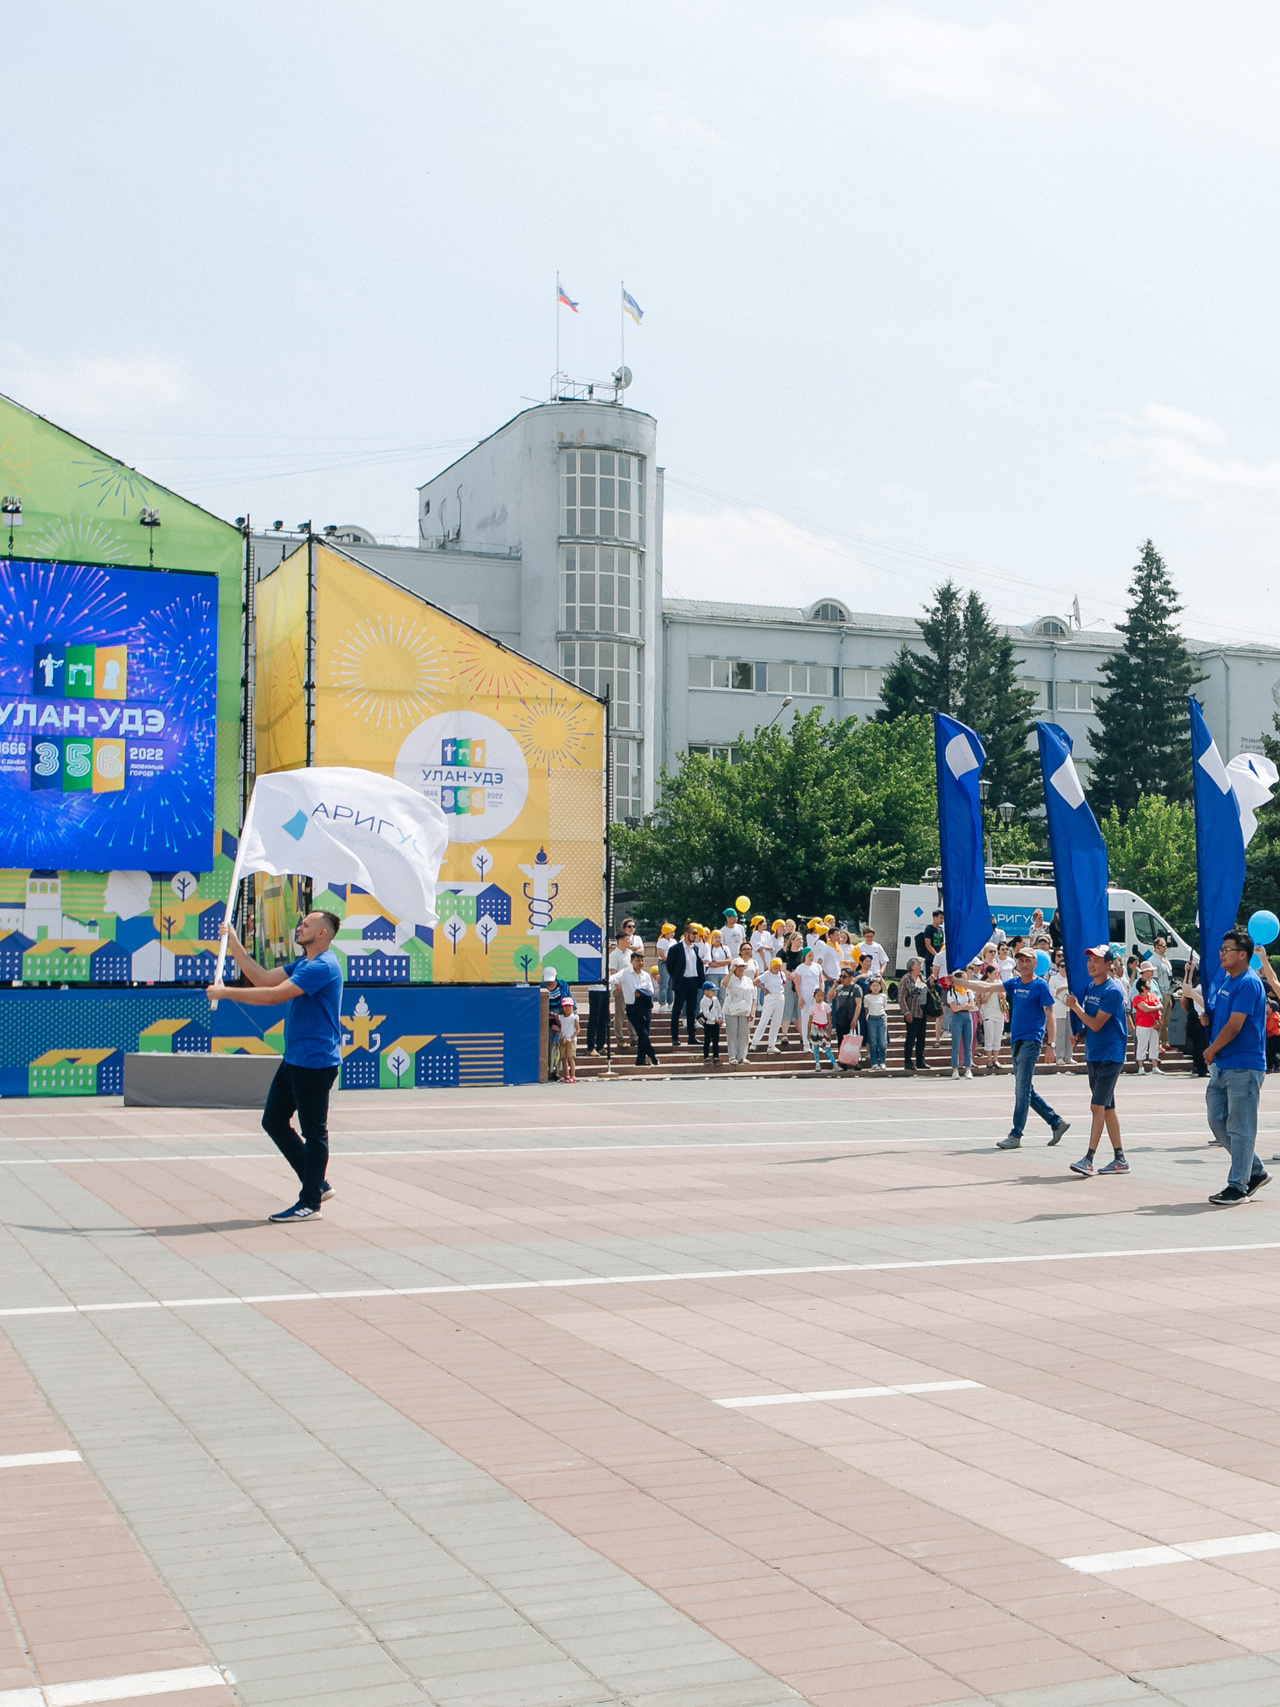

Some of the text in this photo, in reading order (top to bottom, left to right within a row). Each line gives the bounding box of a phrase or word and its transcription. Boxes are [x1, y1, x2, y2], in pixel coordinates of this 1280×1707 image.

[0, 702, 166, 737] УЛАН-УДЭ
[34, 742, 123, 779] 356
[129, 747, 164, 761] 2022
[421, 769, 504, 787] УЛАН-УДЭ
